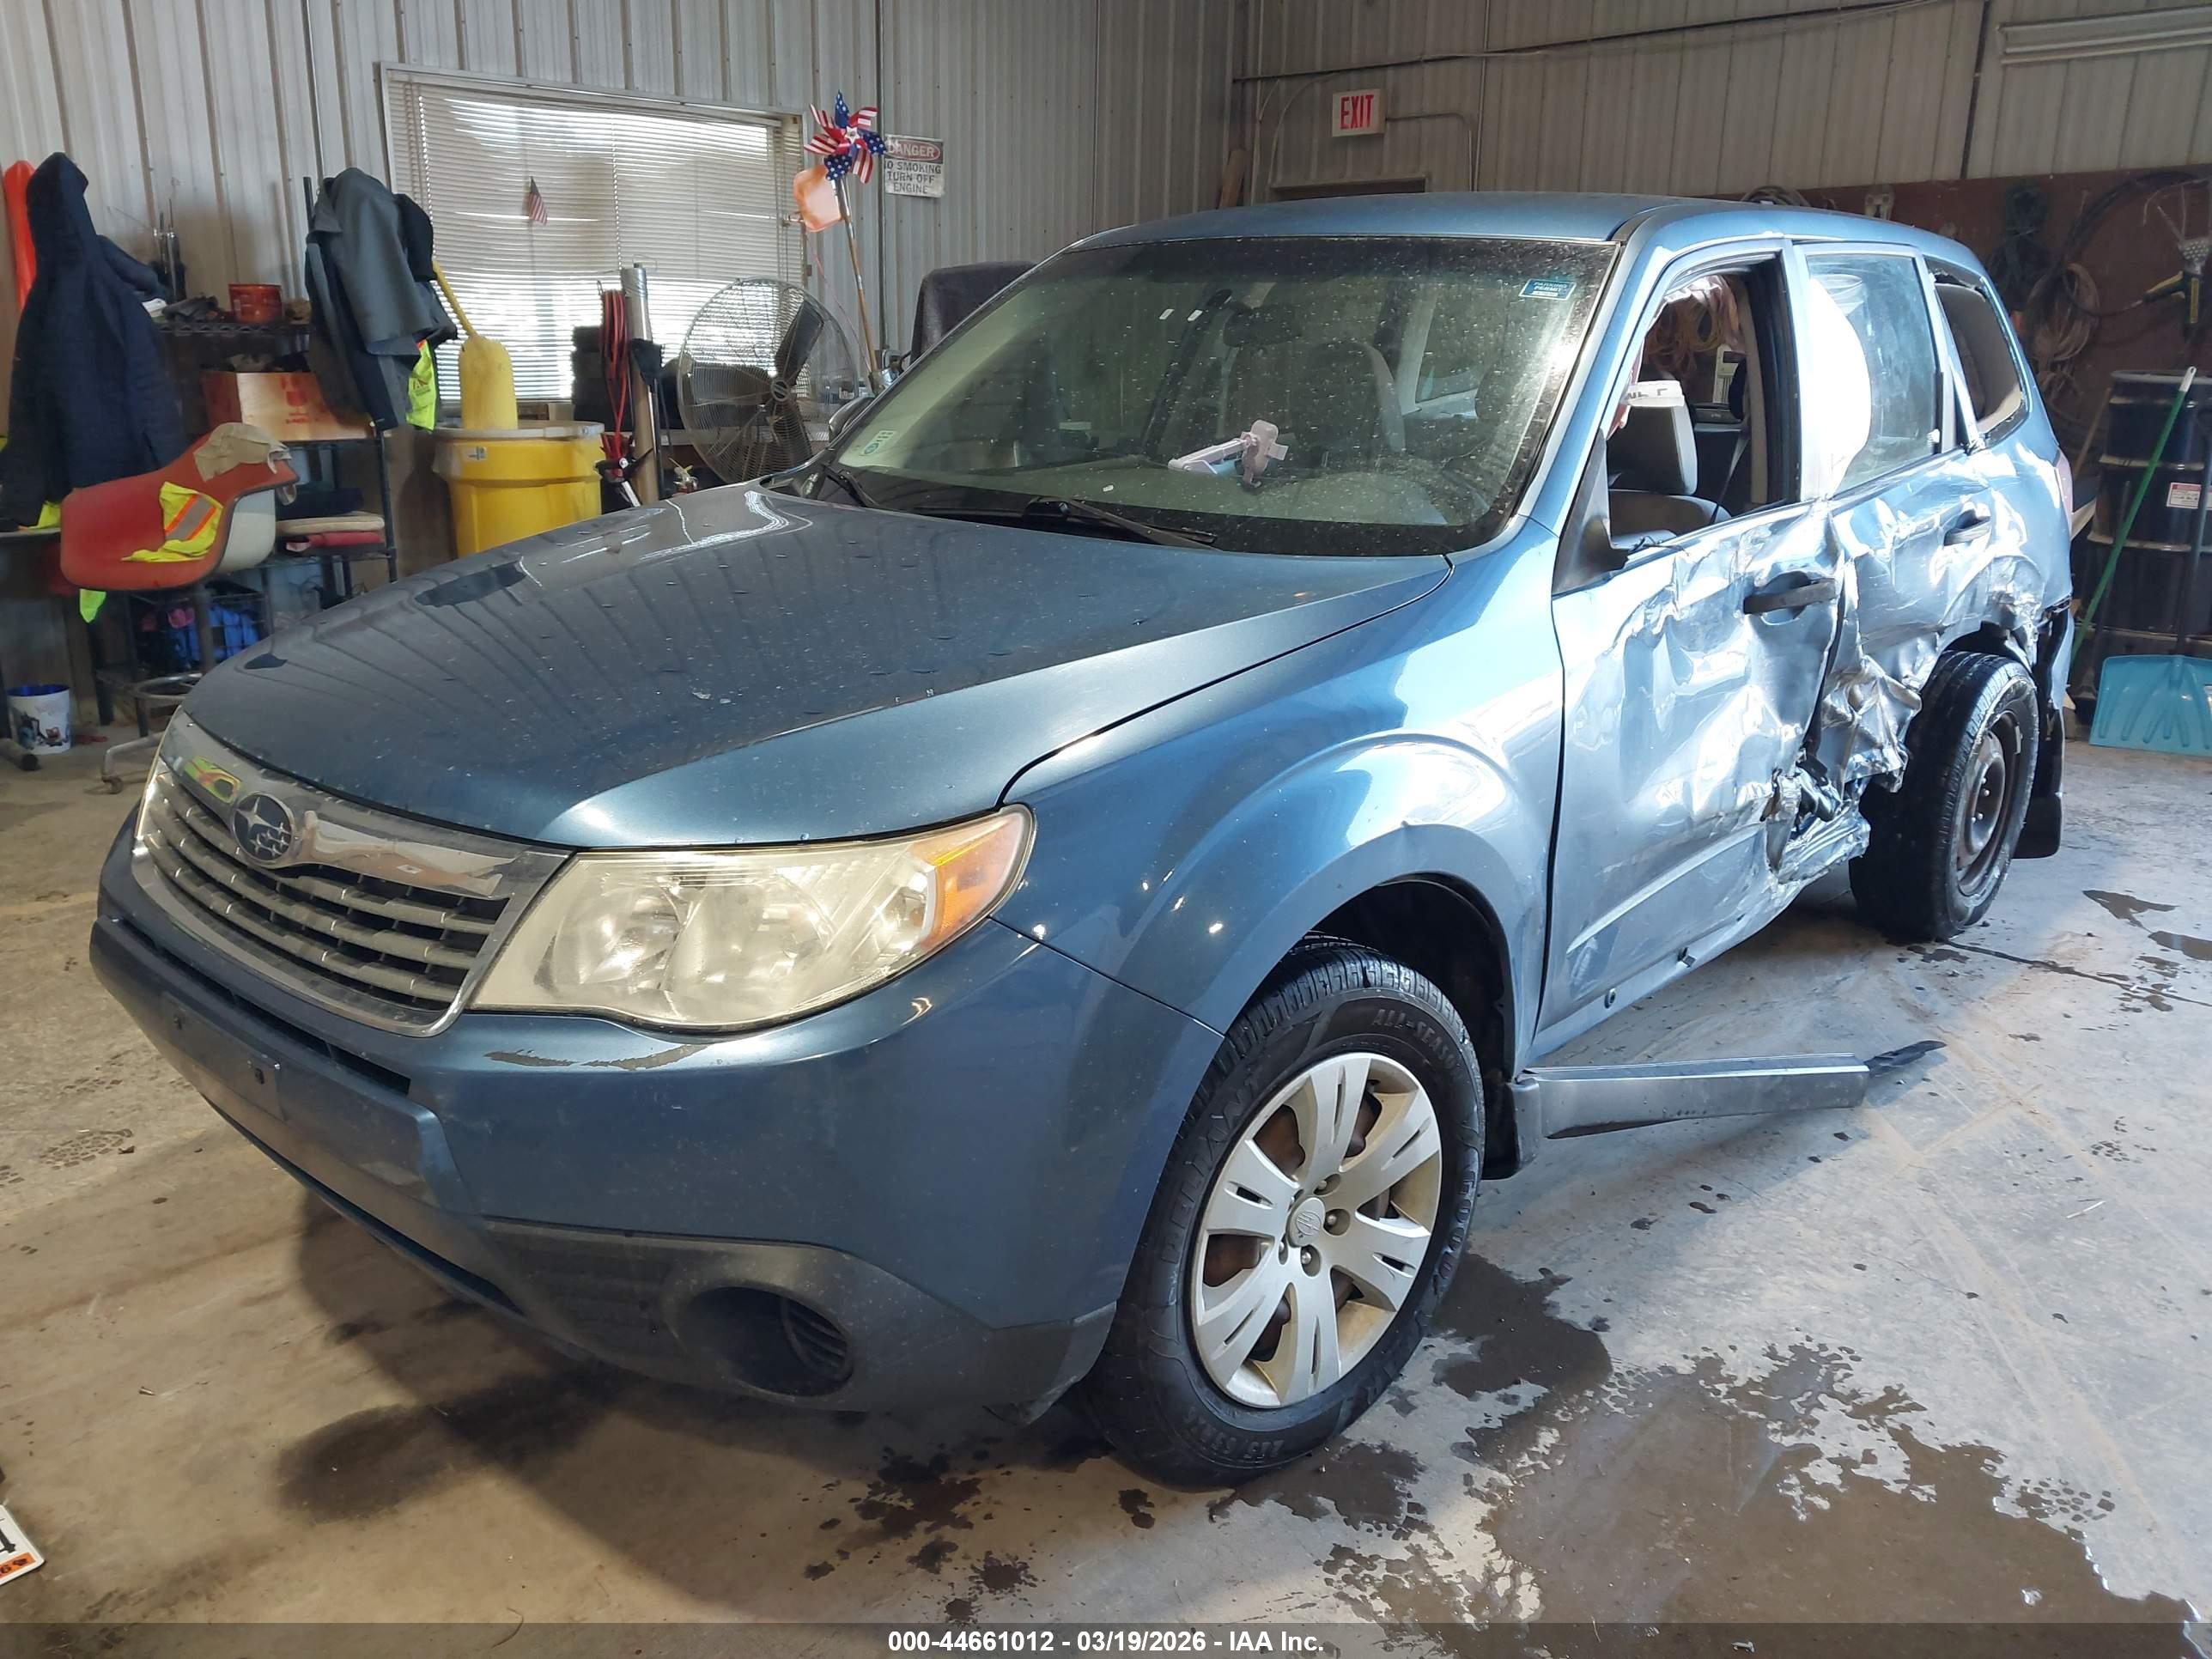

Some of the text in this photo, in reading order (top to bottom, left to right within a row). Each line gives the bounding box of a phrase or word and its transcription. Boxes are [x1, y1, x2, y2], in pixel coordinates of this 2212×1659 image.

[1340, 94, 1374, 130] EXIT
[887, 142, 935, 158] DANGER
[896, 161, 941, 174] SMOKING
[887, 171, 935, 185] TURN OFF
[893, 182, 928, 193] ENGINE
